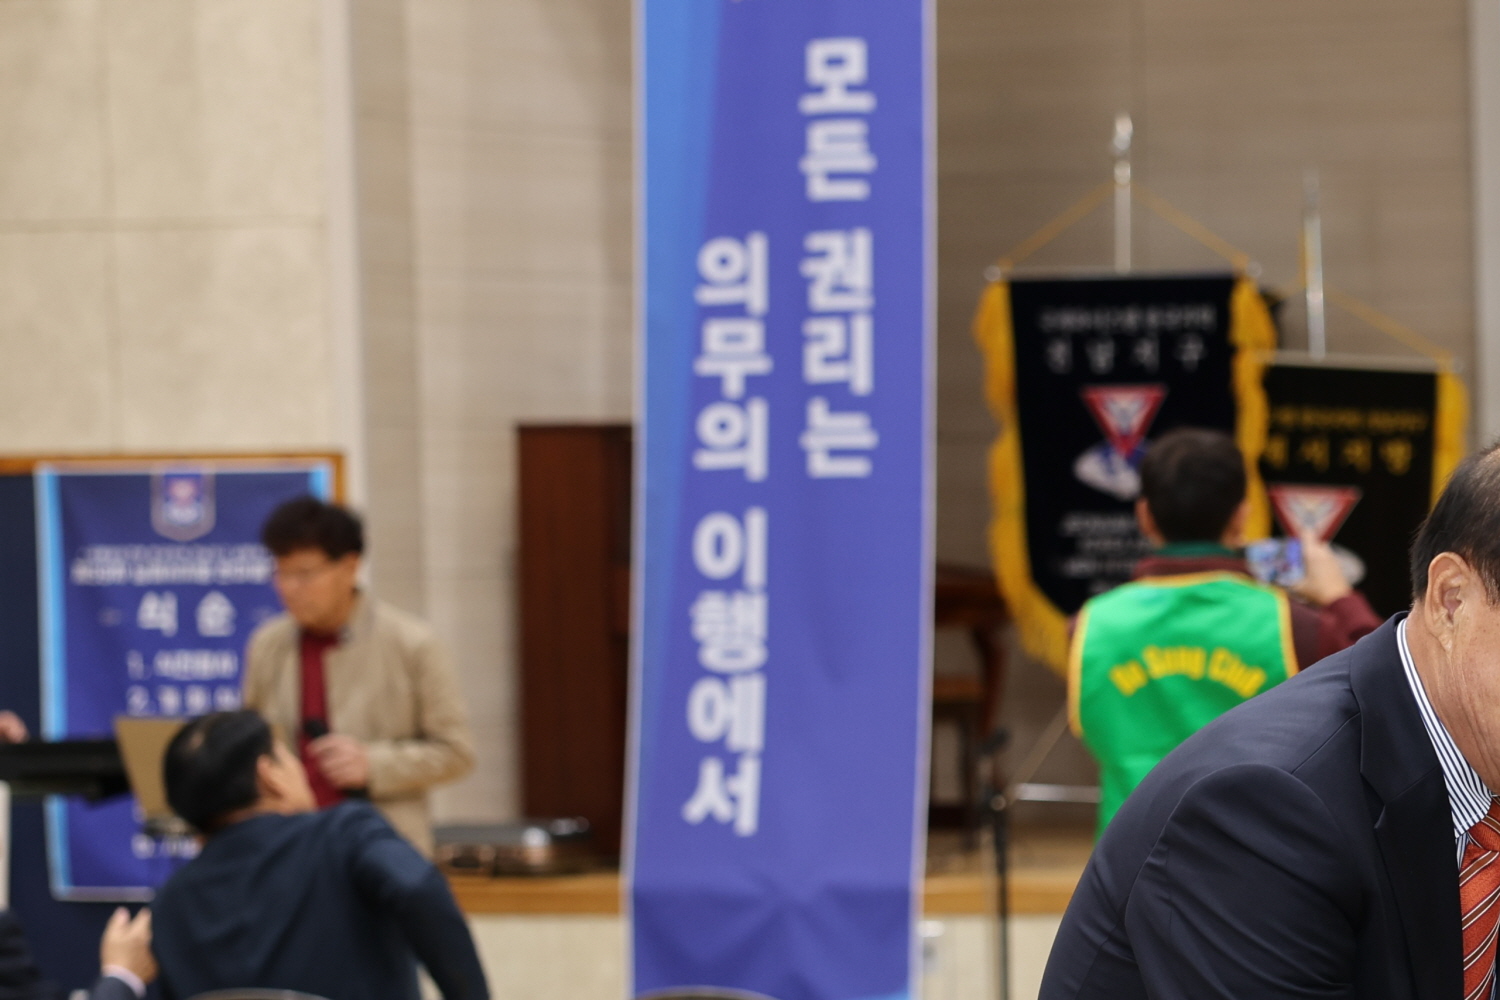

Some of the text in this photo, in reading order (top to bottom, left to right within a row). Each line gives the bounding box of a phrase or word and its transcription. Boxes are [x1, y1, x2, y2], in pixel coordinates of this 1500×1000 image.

[799, 38, 878, 478] 모든 권리는
[682, 231, 773, 836] 의무의 이행에서
[1142, 645, 1206, 680] Sung
